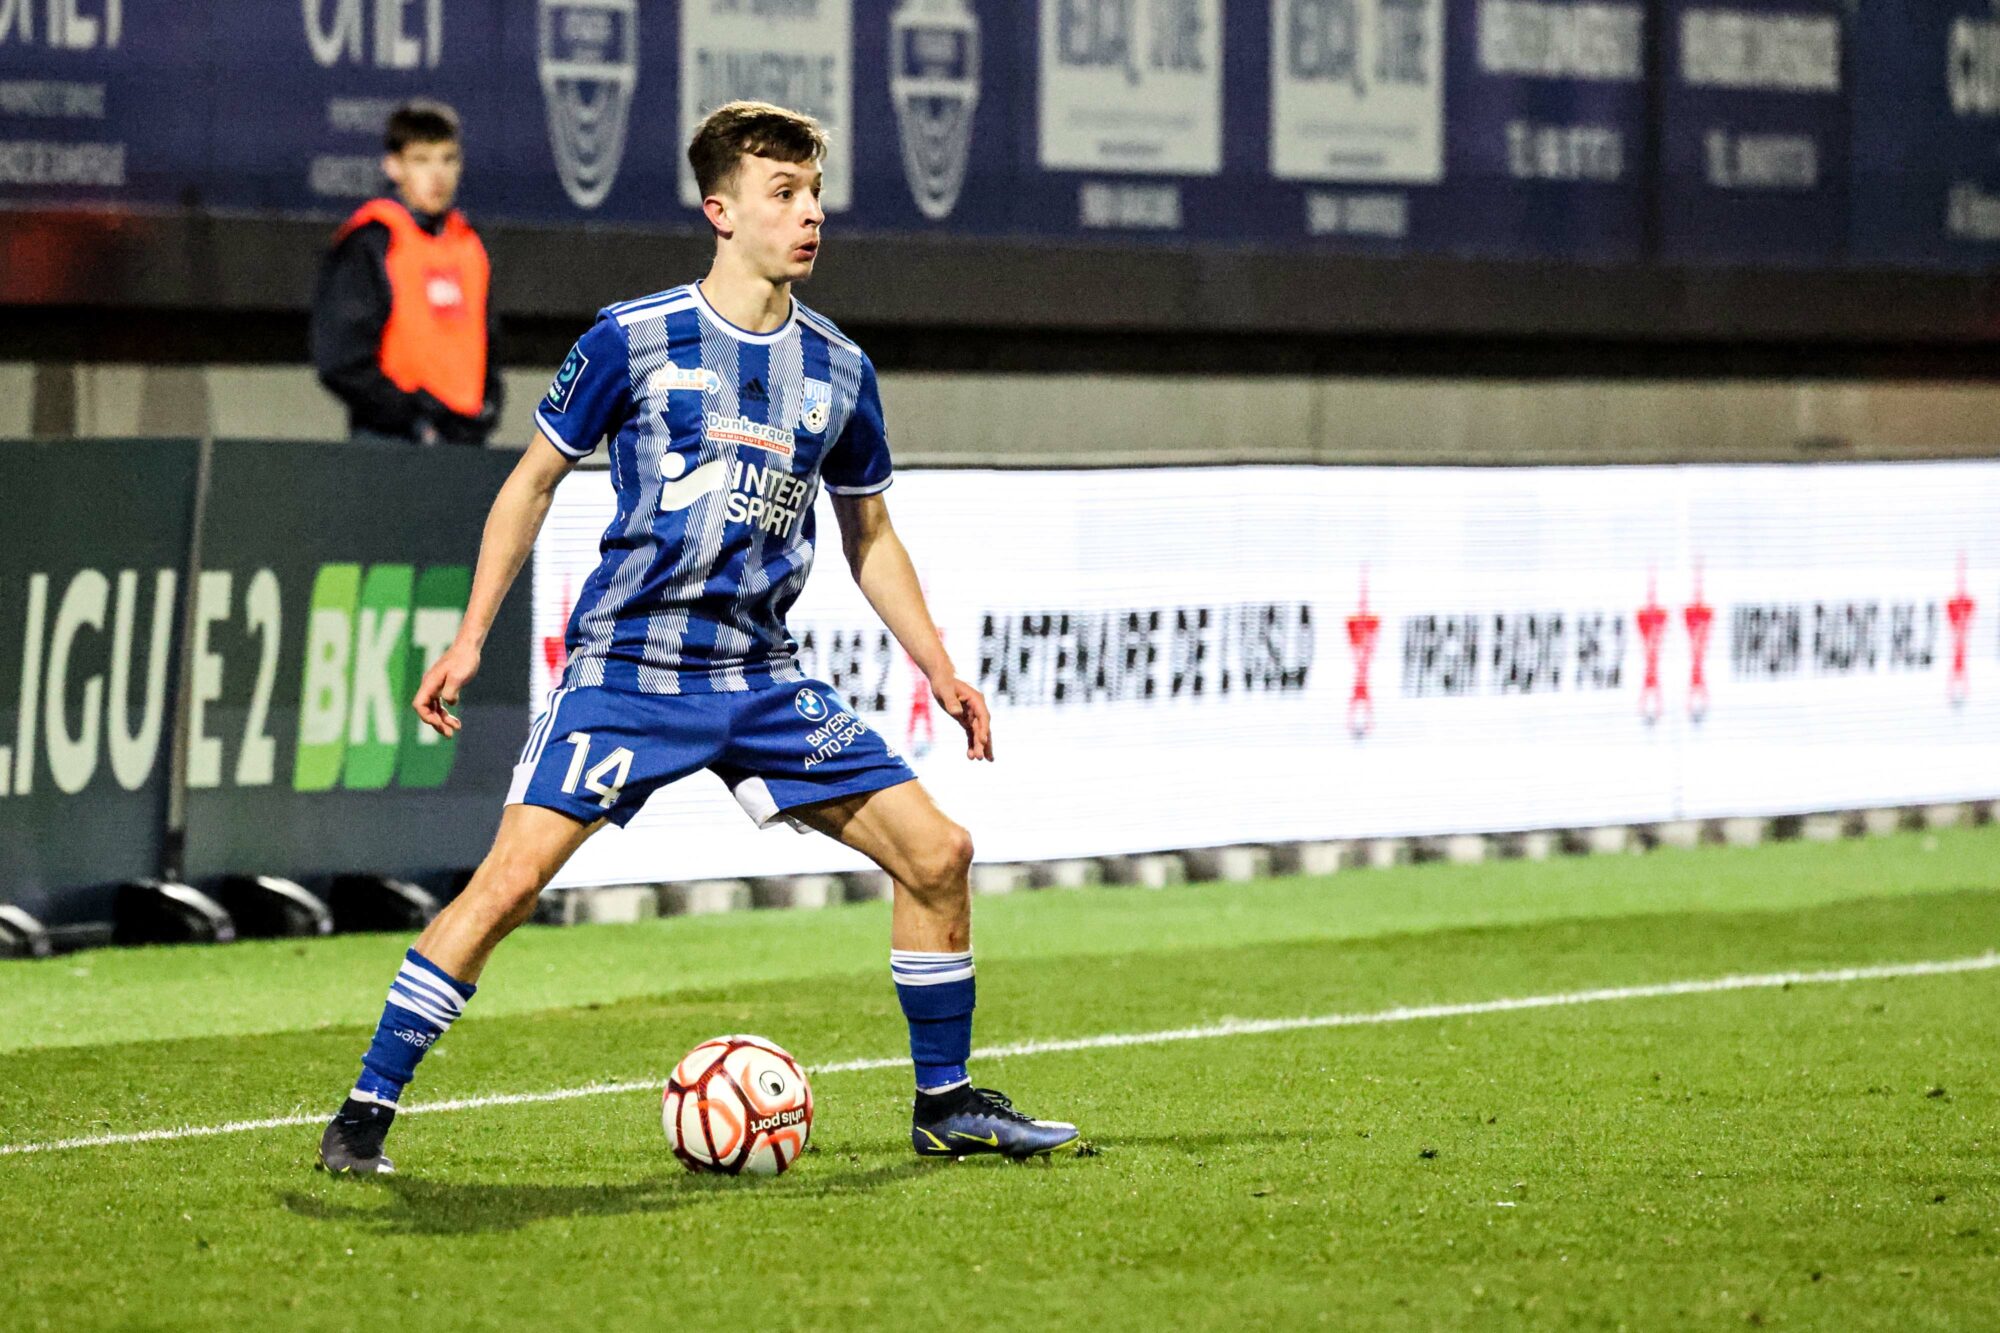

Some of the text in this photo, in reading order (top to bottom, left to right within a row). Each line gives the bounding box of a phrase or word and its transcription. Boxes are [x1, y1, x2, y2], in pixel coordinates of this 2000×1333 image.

[709, 414, 793, 443] Dunkerque
[733, 460, 808, 509] INTER
[725, 492, 797, 539] SPORT
[236, 568, 282, 786] 2
[302, 607, 463, 746] BKT
[805, 711, 854, 747] BAYERN
[561, 731, 634, 809] 14
[804, 740, 841, 770] AUTO
